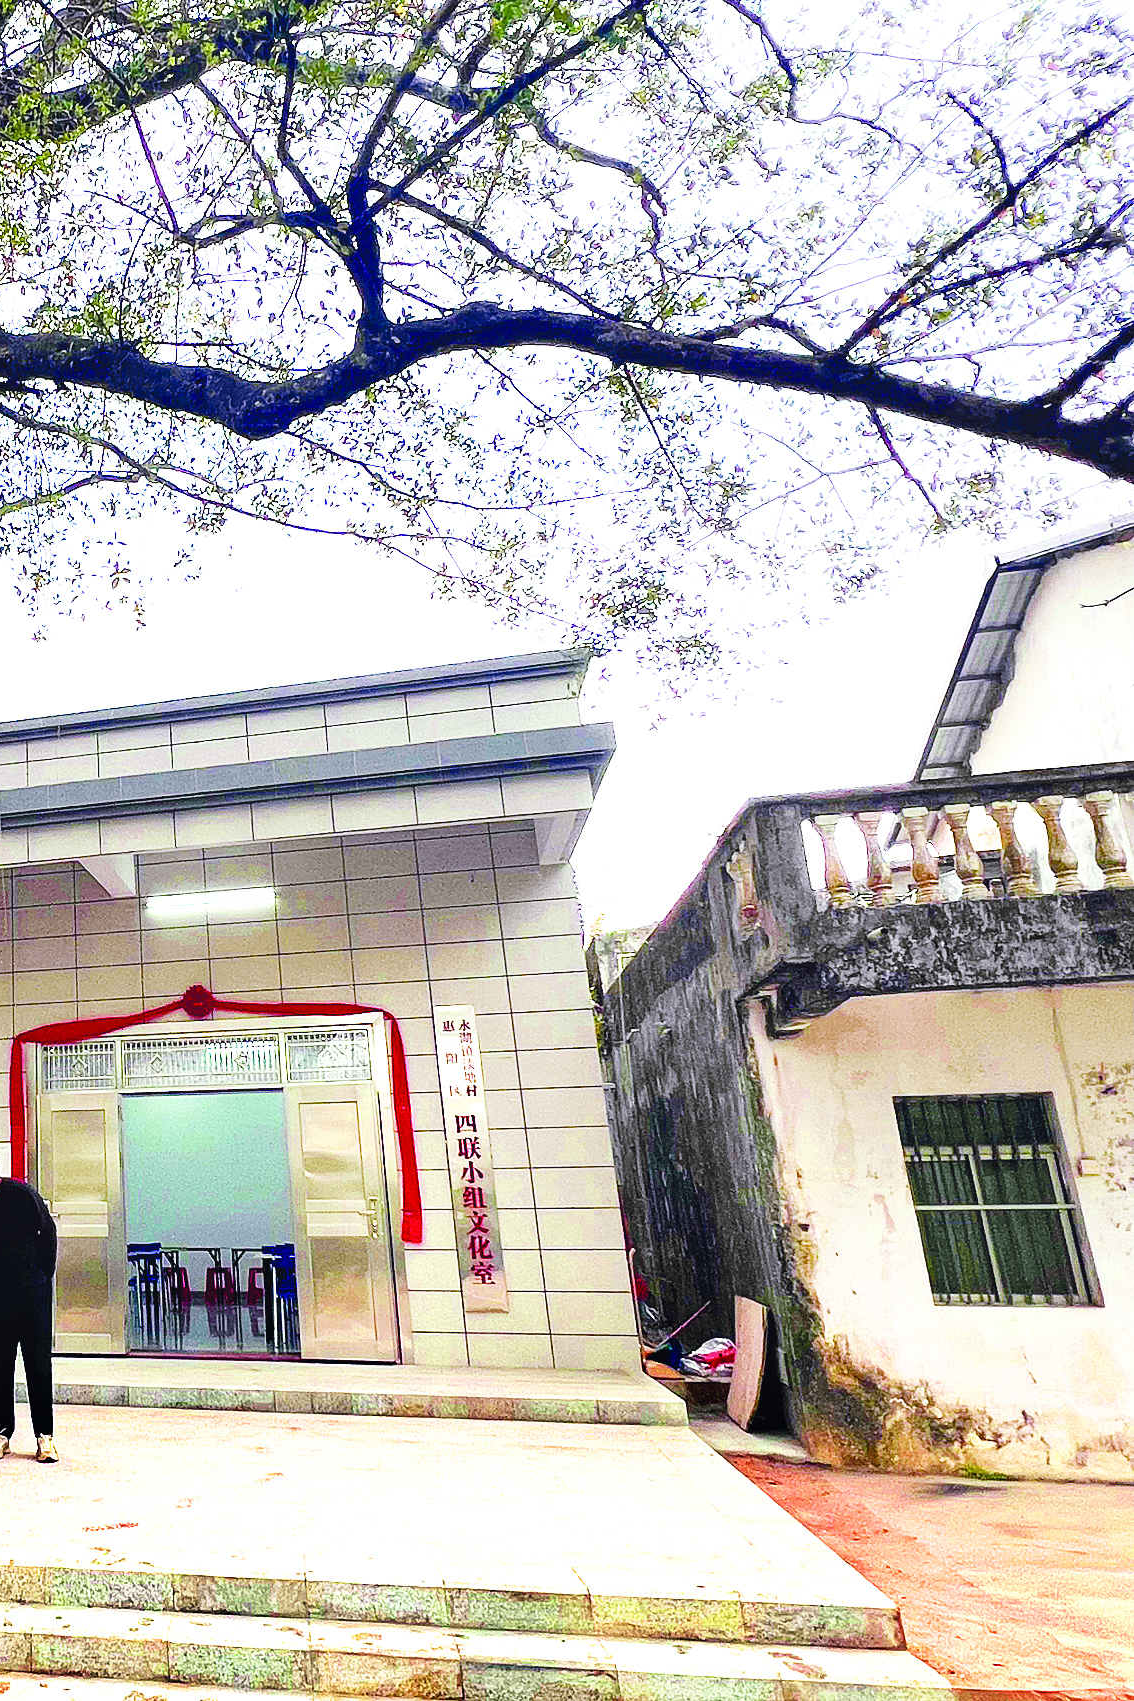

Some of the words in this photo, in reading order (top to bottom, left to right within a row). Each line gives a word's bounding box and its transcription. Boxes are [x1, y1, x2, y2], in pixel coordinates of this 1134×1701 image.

[454, 1114, 496, 1285] 四联小组文化室
